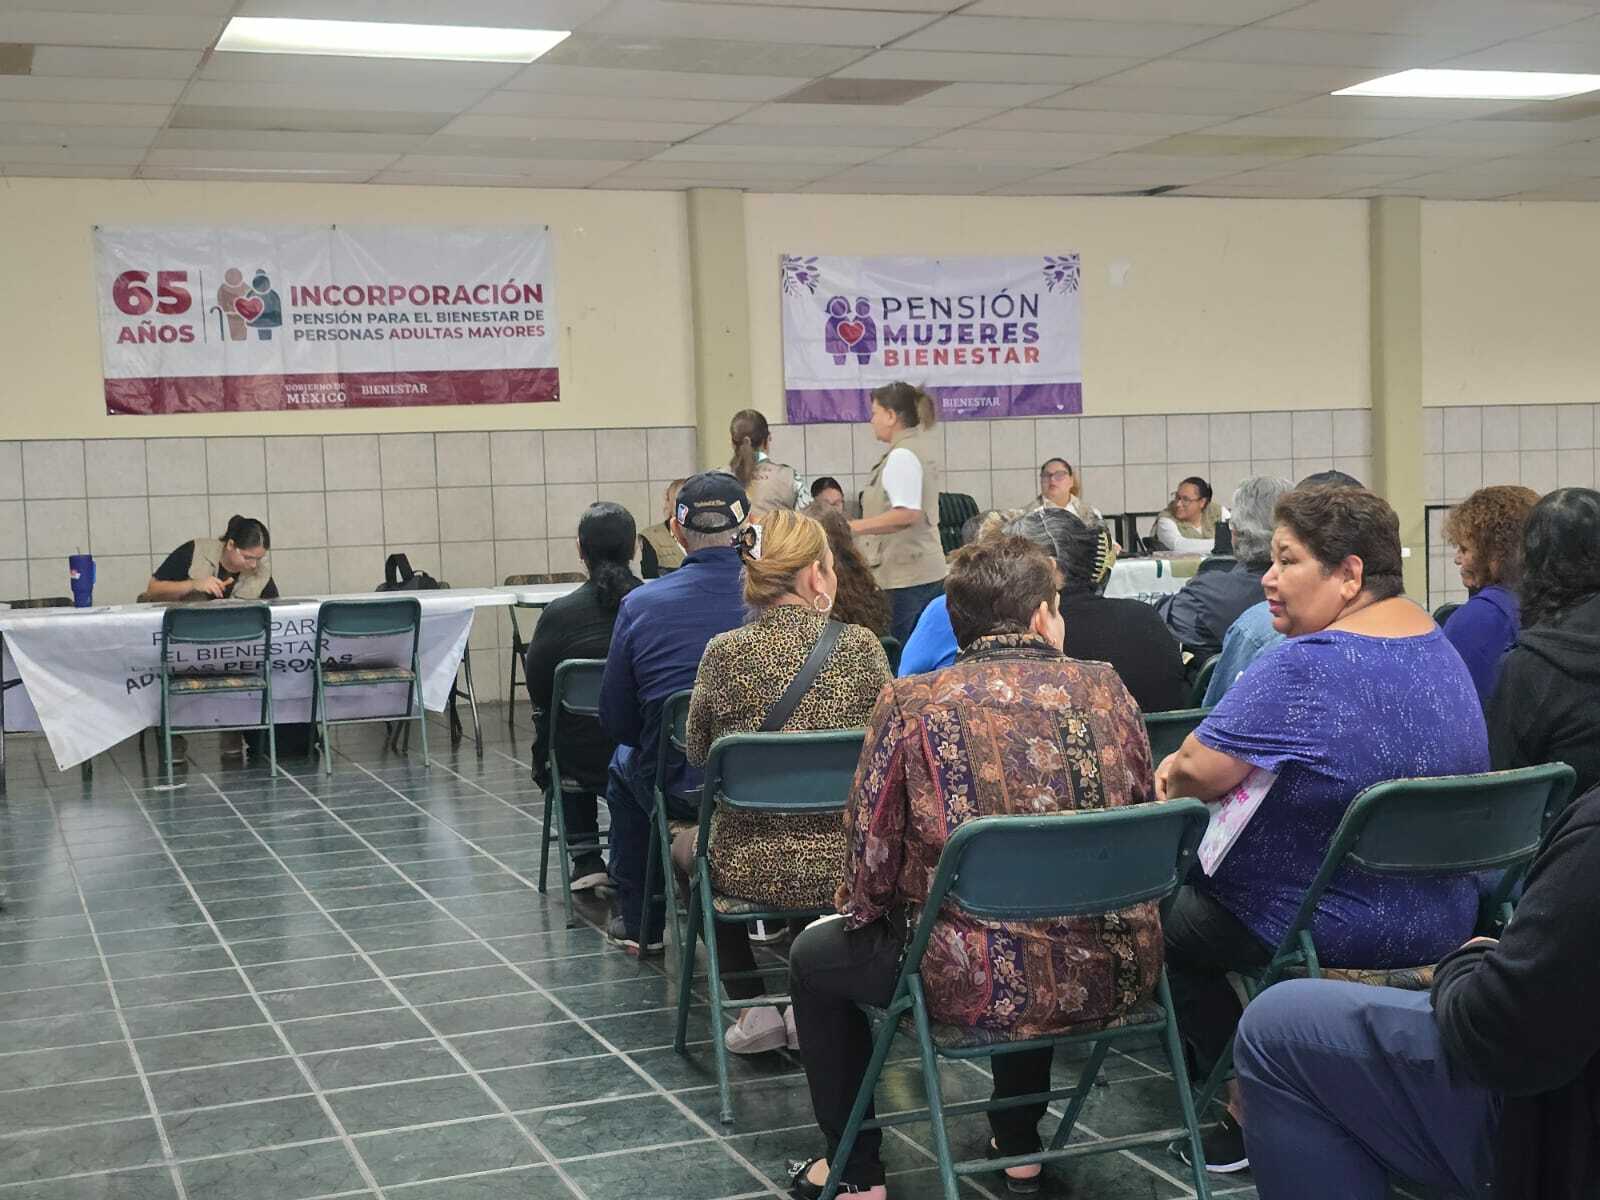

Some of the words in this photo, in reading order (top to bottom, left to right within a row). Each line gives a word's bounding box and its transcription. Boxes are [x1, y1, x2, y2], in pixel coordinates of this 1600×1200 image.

[112, 270, 192, 315] 65
[290, 278, 543, 306] INCORPORACIÓN
[882, 289, 1039, 320] PENSIÓN
[293, 310, 362, 324] PENSIÓN
[368, 312, 410, 323] PARA
[414, 312, 432, 323] EL
[436, 311, 520, 322] BIENESTAR
[524, 310, 544, 321] DE
[117, 320, 195, 344] AÑOS
[294, 328, 384, 341] PERSONAS
[389, 327, 463, 340] ADULTAS
[468, 325, 544, 338] MAYORES
[883, 322, 1040, 346] MUJERES
[884, 346, 1040, 367] BIENESTAR
[284, 383, 332, 393] GOBIERNO
[361, 383, 428, 396] BIENESTAR
[942, 397, 1001, 408] BIENESTAR
[197, 638, 331, 661] BIENESTAR
